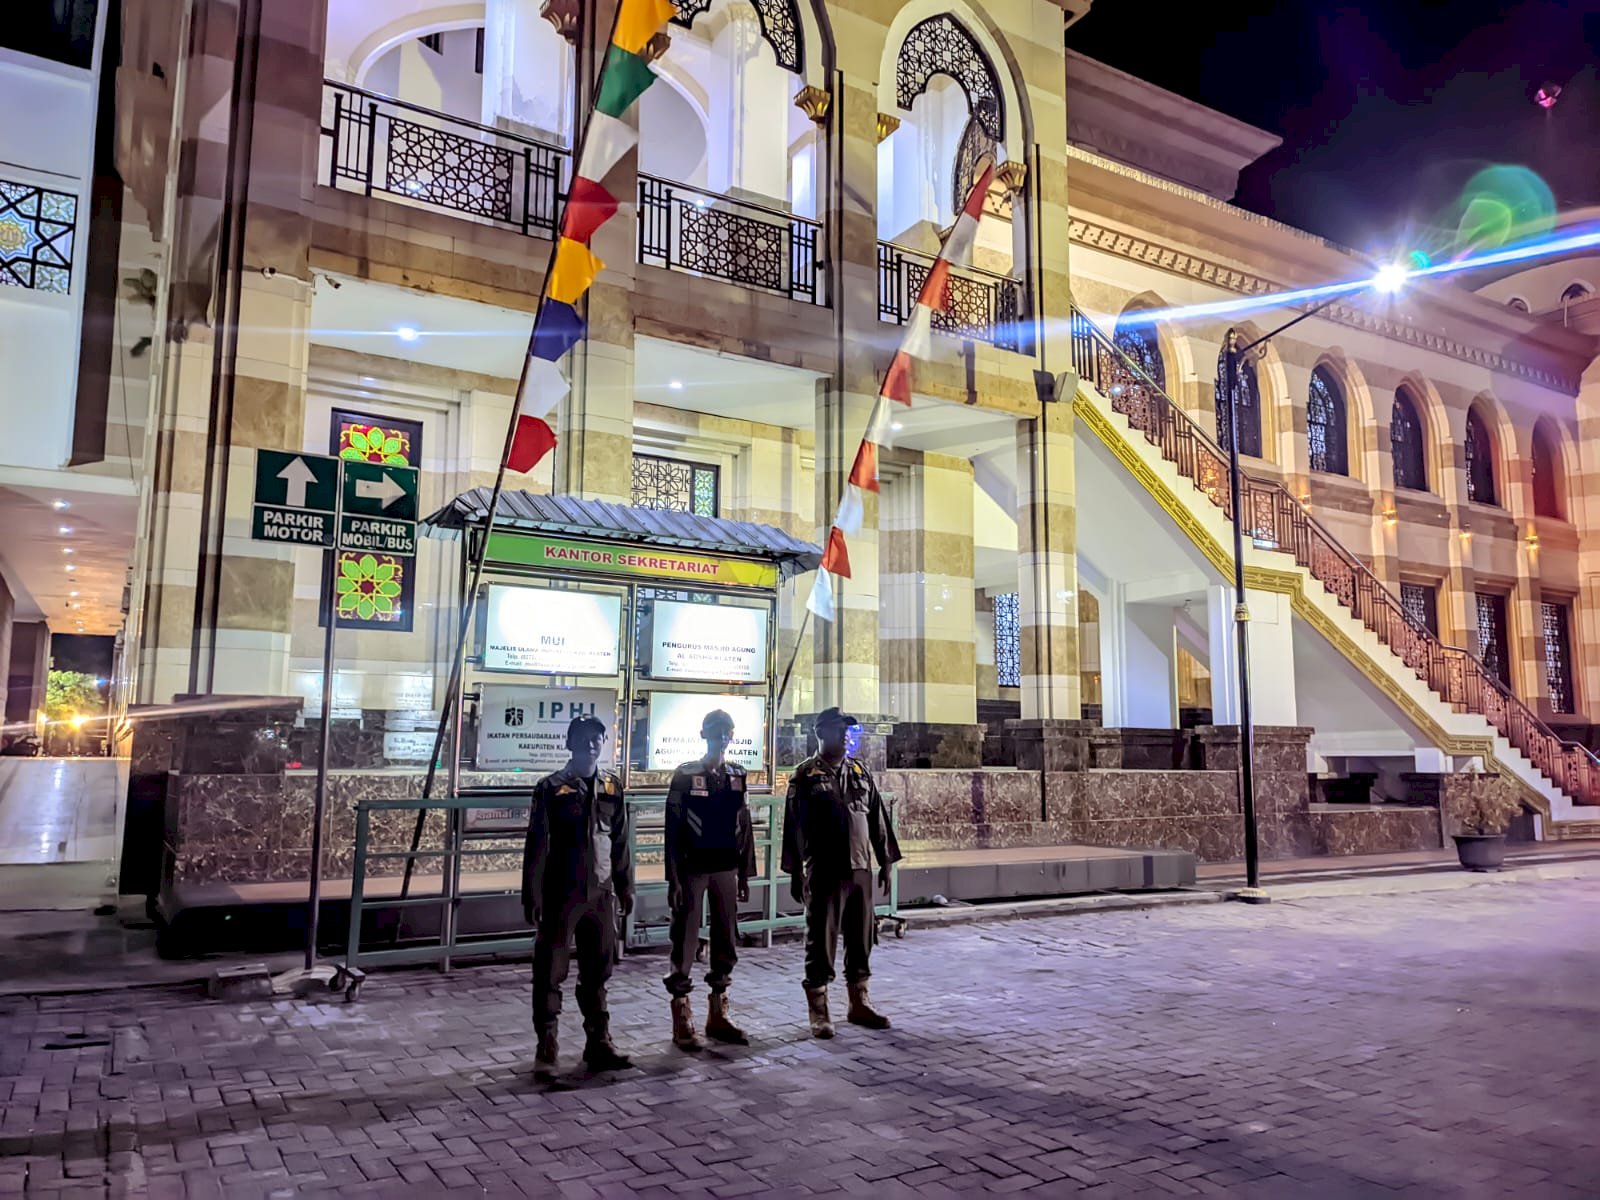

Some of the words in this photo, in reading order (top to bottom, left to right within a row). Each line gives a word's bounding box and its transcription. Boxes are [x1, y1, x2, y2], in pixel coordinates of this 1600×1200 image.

[263, 510, 324, 529] PARKIR
[263, 525, 323, 542] MOTOR
[351, 520, 407, 537] PARKIR
[342, 532, 413, 551] MOBIL/BUS
[544, 545, 613, 564] KANTOR
[618, 554, 719, 575] SEKRETARIAT
[541, 635, 565, 646] MUI
[662, 641, 702, 650] PENGURUS
[731, 646, 756, 654] AGUNG
[539, 701, 595, 719] IPHI
[728, 749, 759, 757] KLATEN
